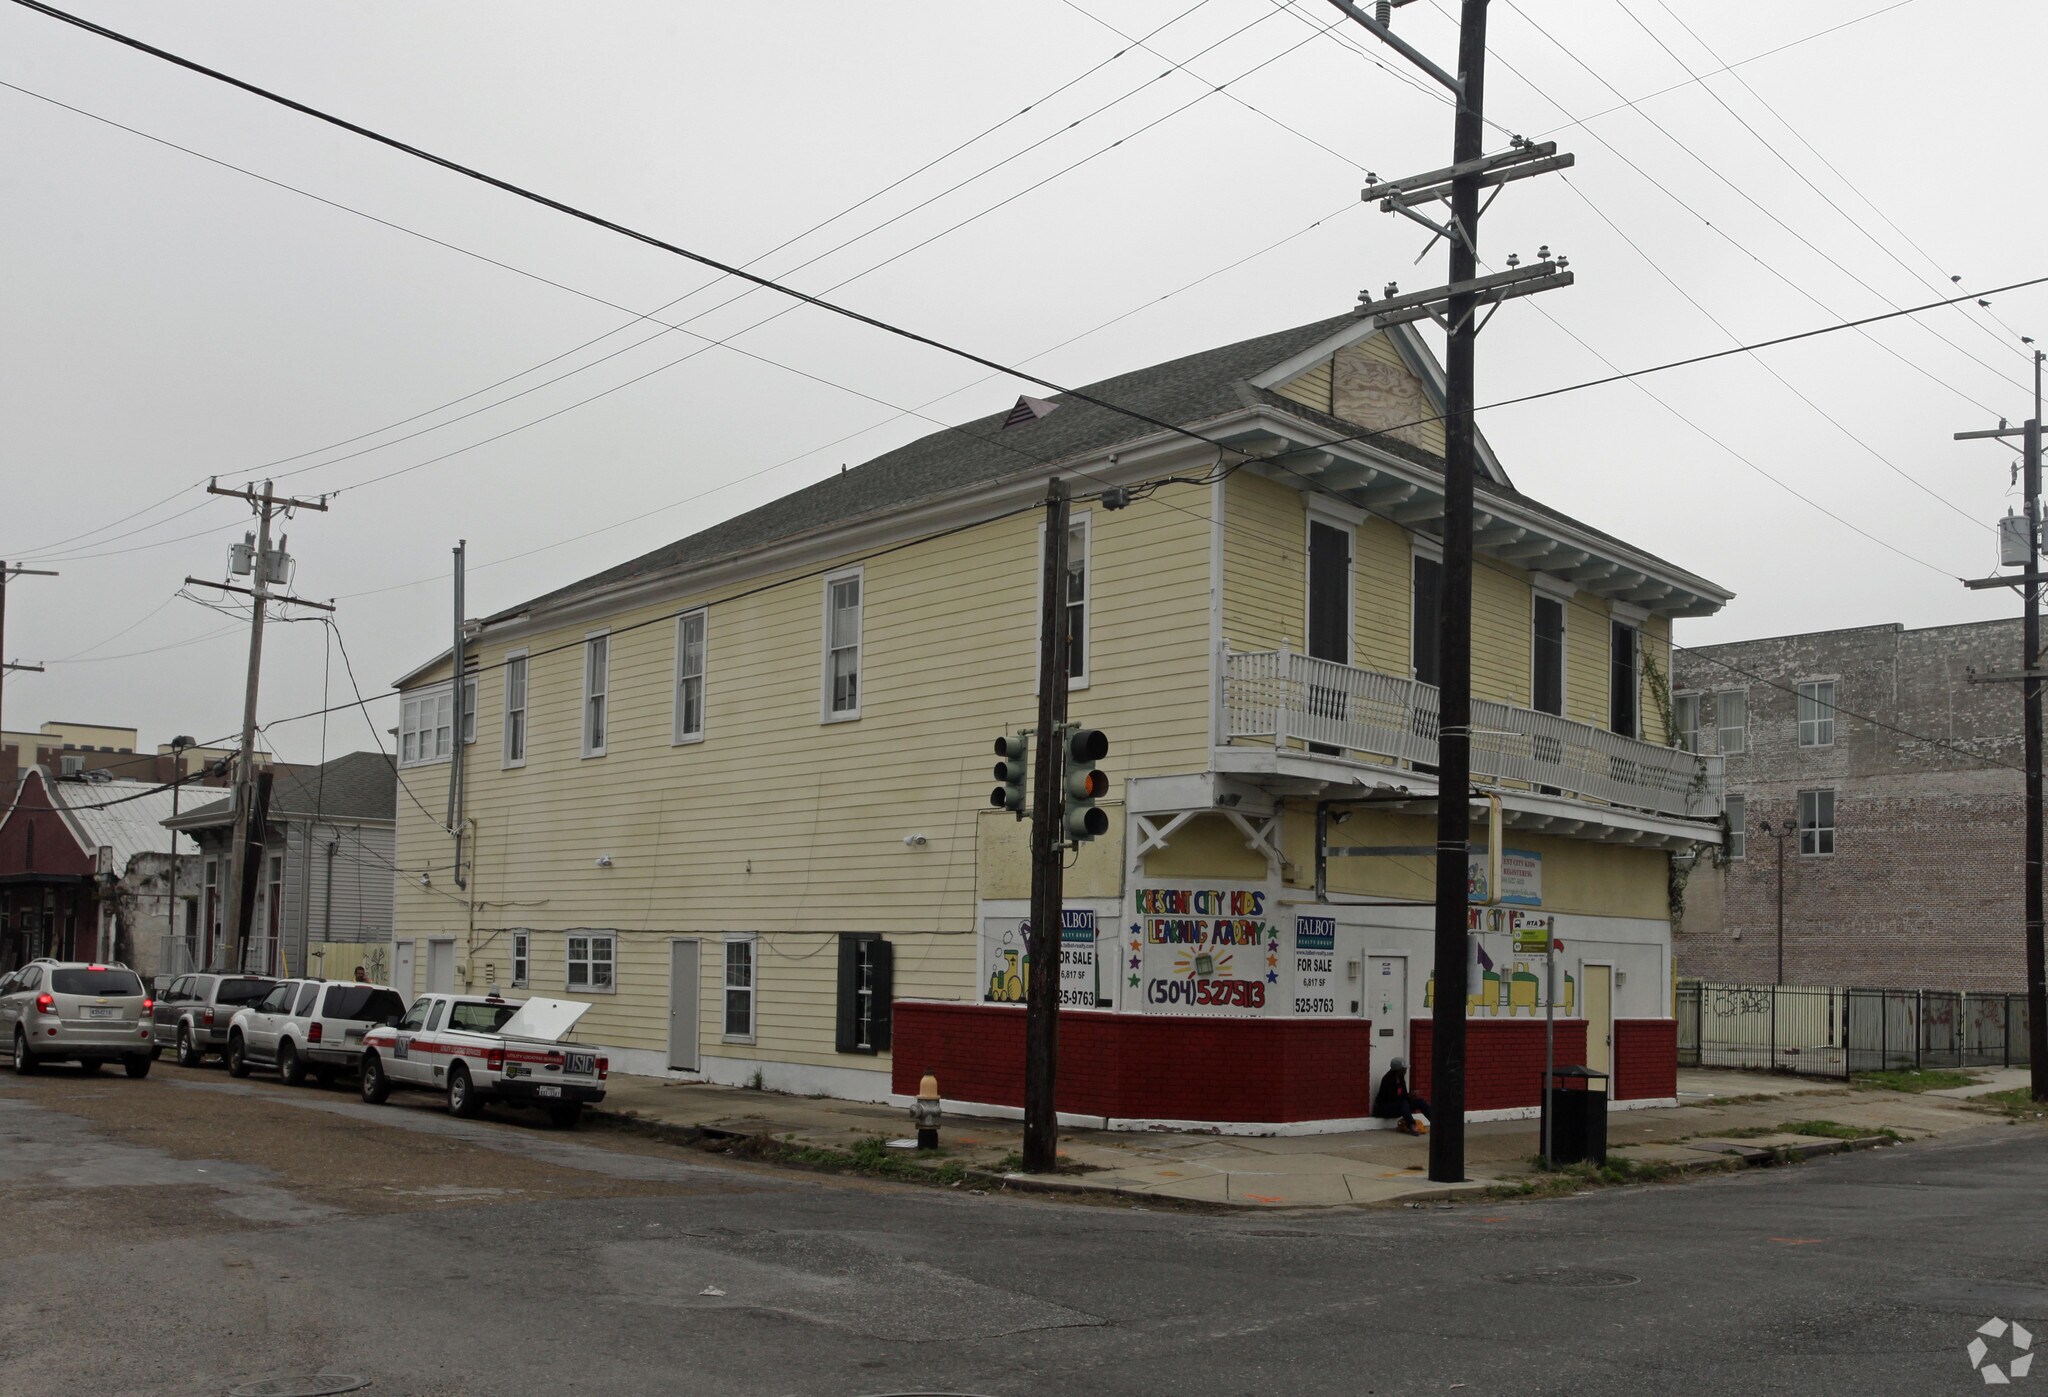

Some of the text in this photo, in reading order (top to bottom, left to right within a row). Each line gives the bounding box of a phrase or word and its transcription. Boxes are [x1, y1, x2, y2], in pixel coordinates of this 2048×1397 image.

[1194, 891, 1225, 915] CITY
[1231, 891, 1265, 916] KIDS
[1061, 912, 1093, 928] ALBOT
[1297, 918, 1335, 936] TALBOT
[1486, 908, 1506, 932] CITY
[1147, 919, 1265, 945] LEARNING ACADEMY
[1060, 951, 1092, 965] OR SALE
[1297, 958, 1332, 972] FOR SALE
[1061, 970, 1085, 980] 6,817 SF
[1303, 978, 1326, 988] 6,817 SF
[1059, 990, 1094, 1006] 25-9763
[1295, 998, 1334, 1012] 525-9763
[565, 1053, 594, 1074] USIC
